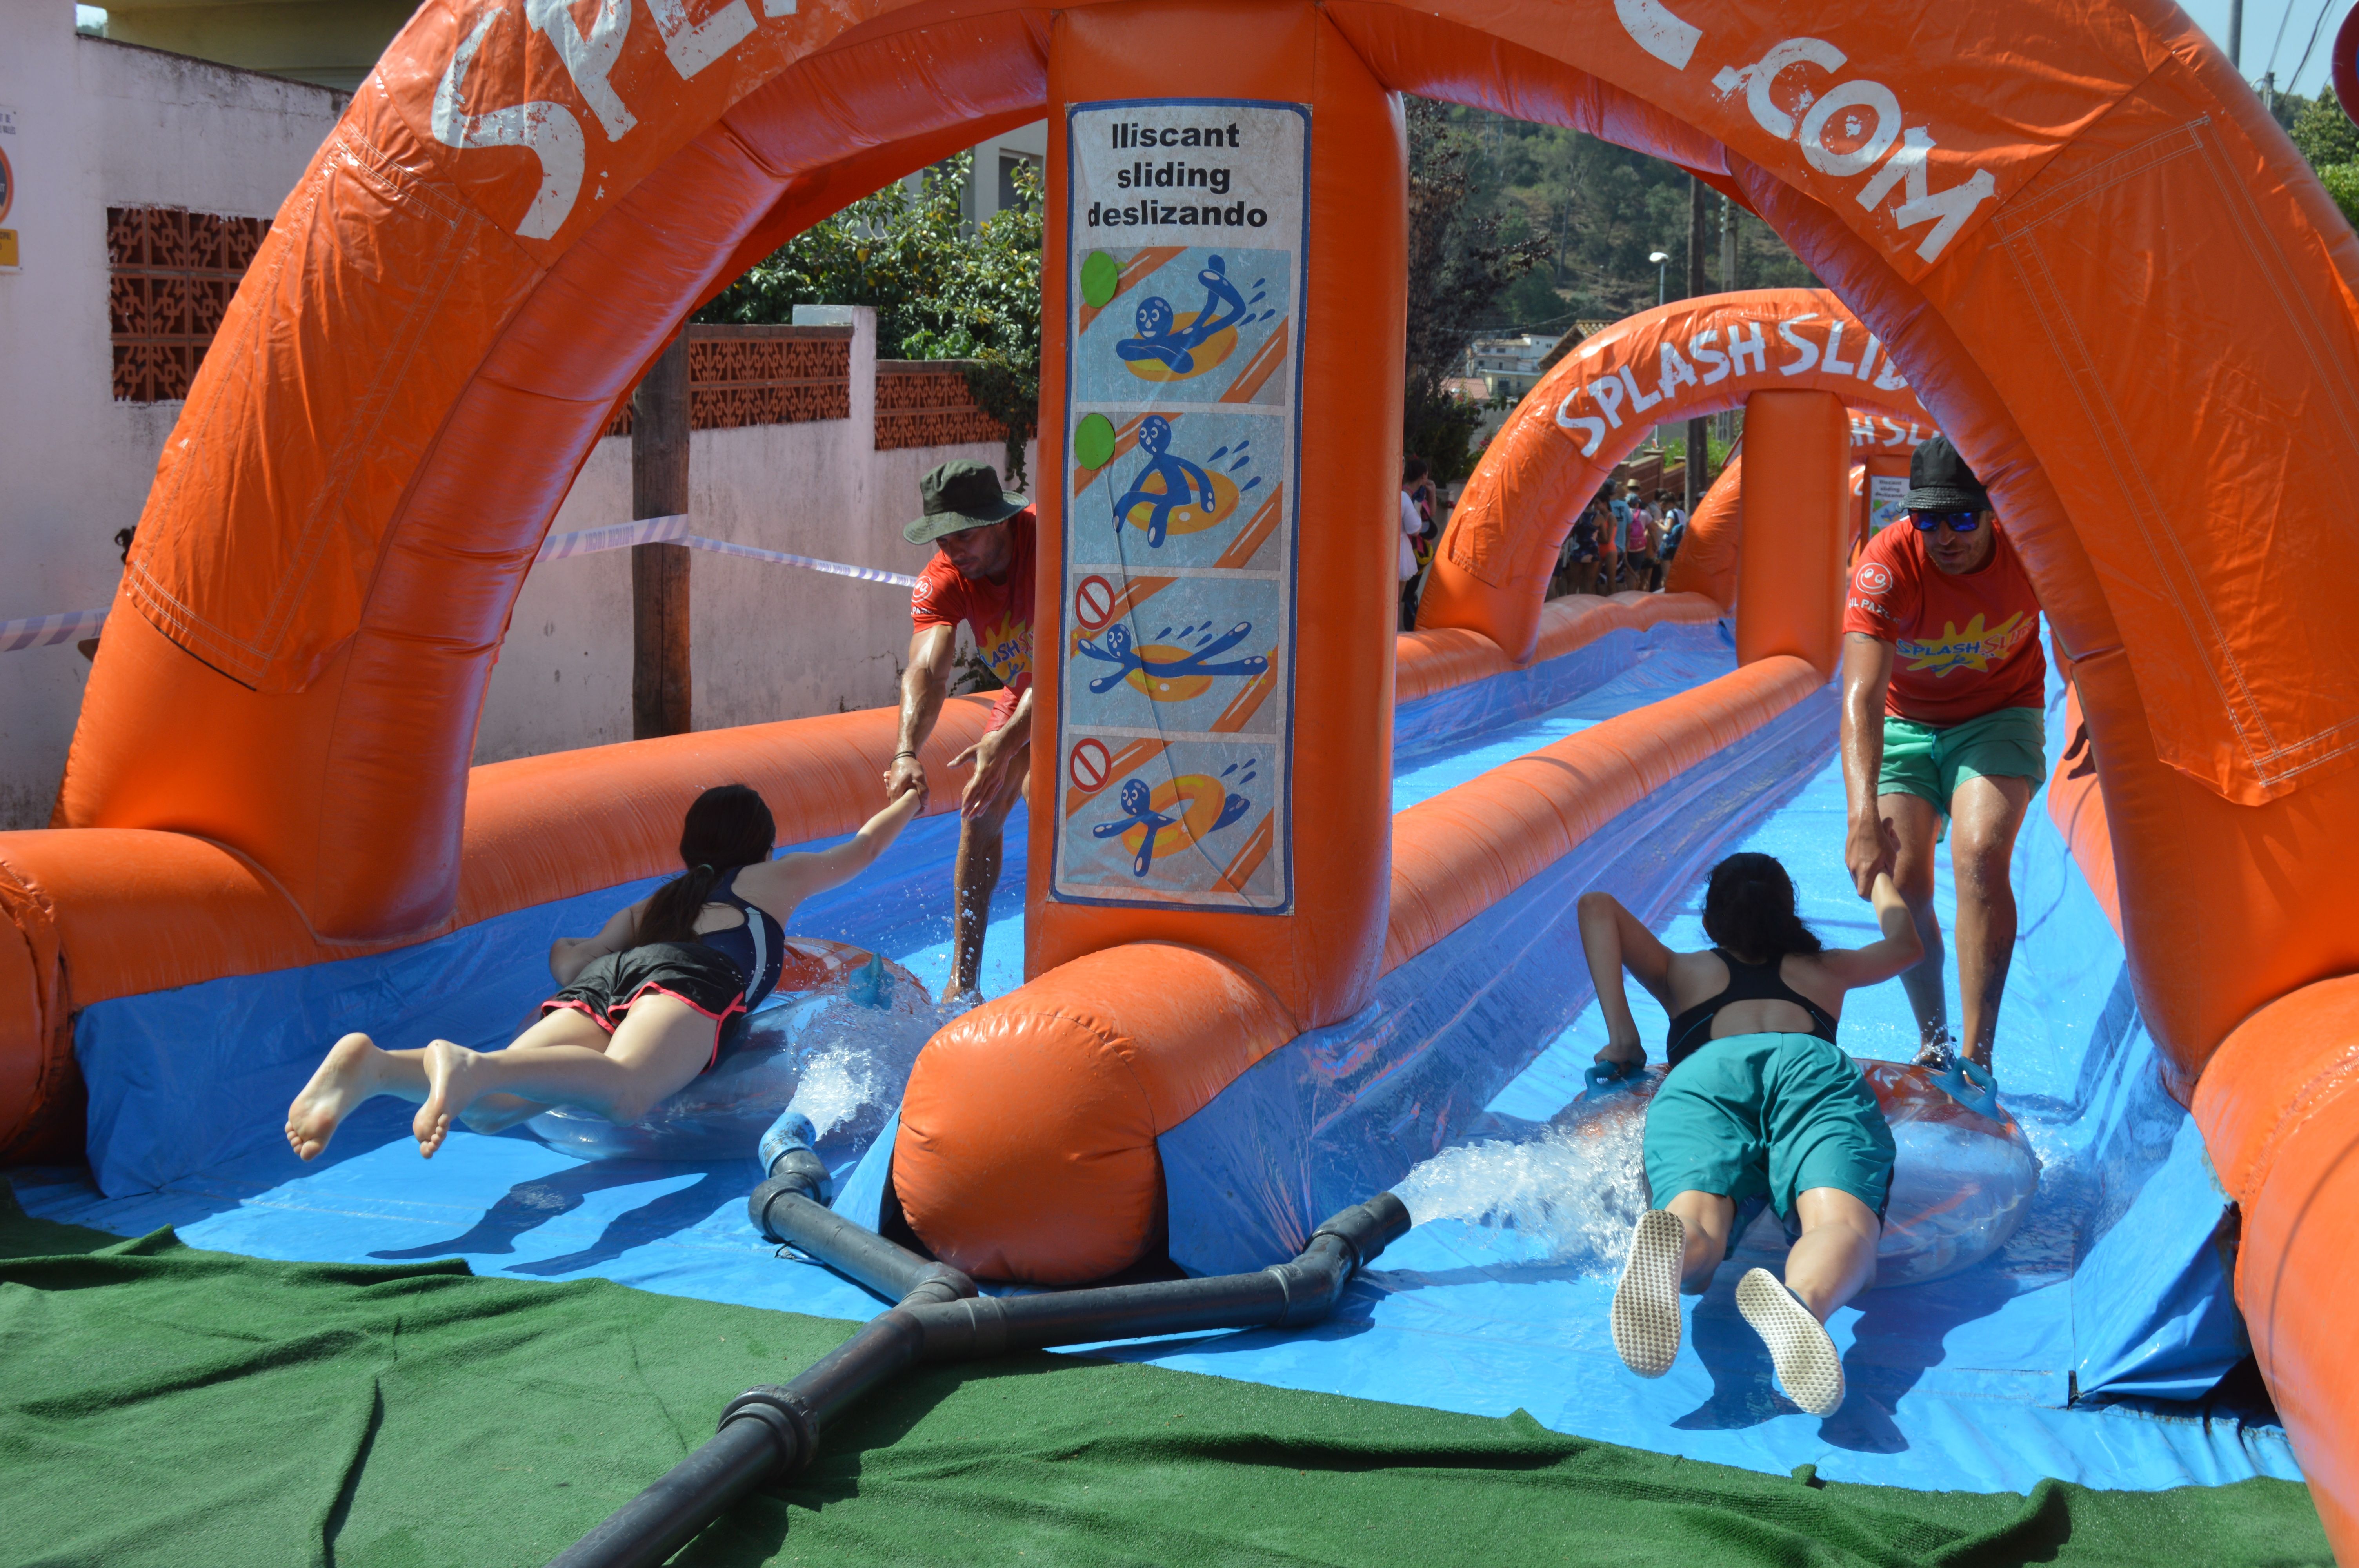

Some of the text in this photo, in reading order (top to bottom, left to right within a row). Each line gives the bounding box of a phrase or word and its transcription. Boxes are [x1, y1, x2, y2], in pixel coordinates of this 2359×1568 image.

[1112, 123, 1239, 149] lliscant
[1118, 162, 1230, 194] sliding
[1088, 200, 1267, 227] deslizando
[1556, 321, 1766, 457] SPLASH
[1850, 416, 1875, 447] H
[1896, 639, 1980, 657] SPLASH
